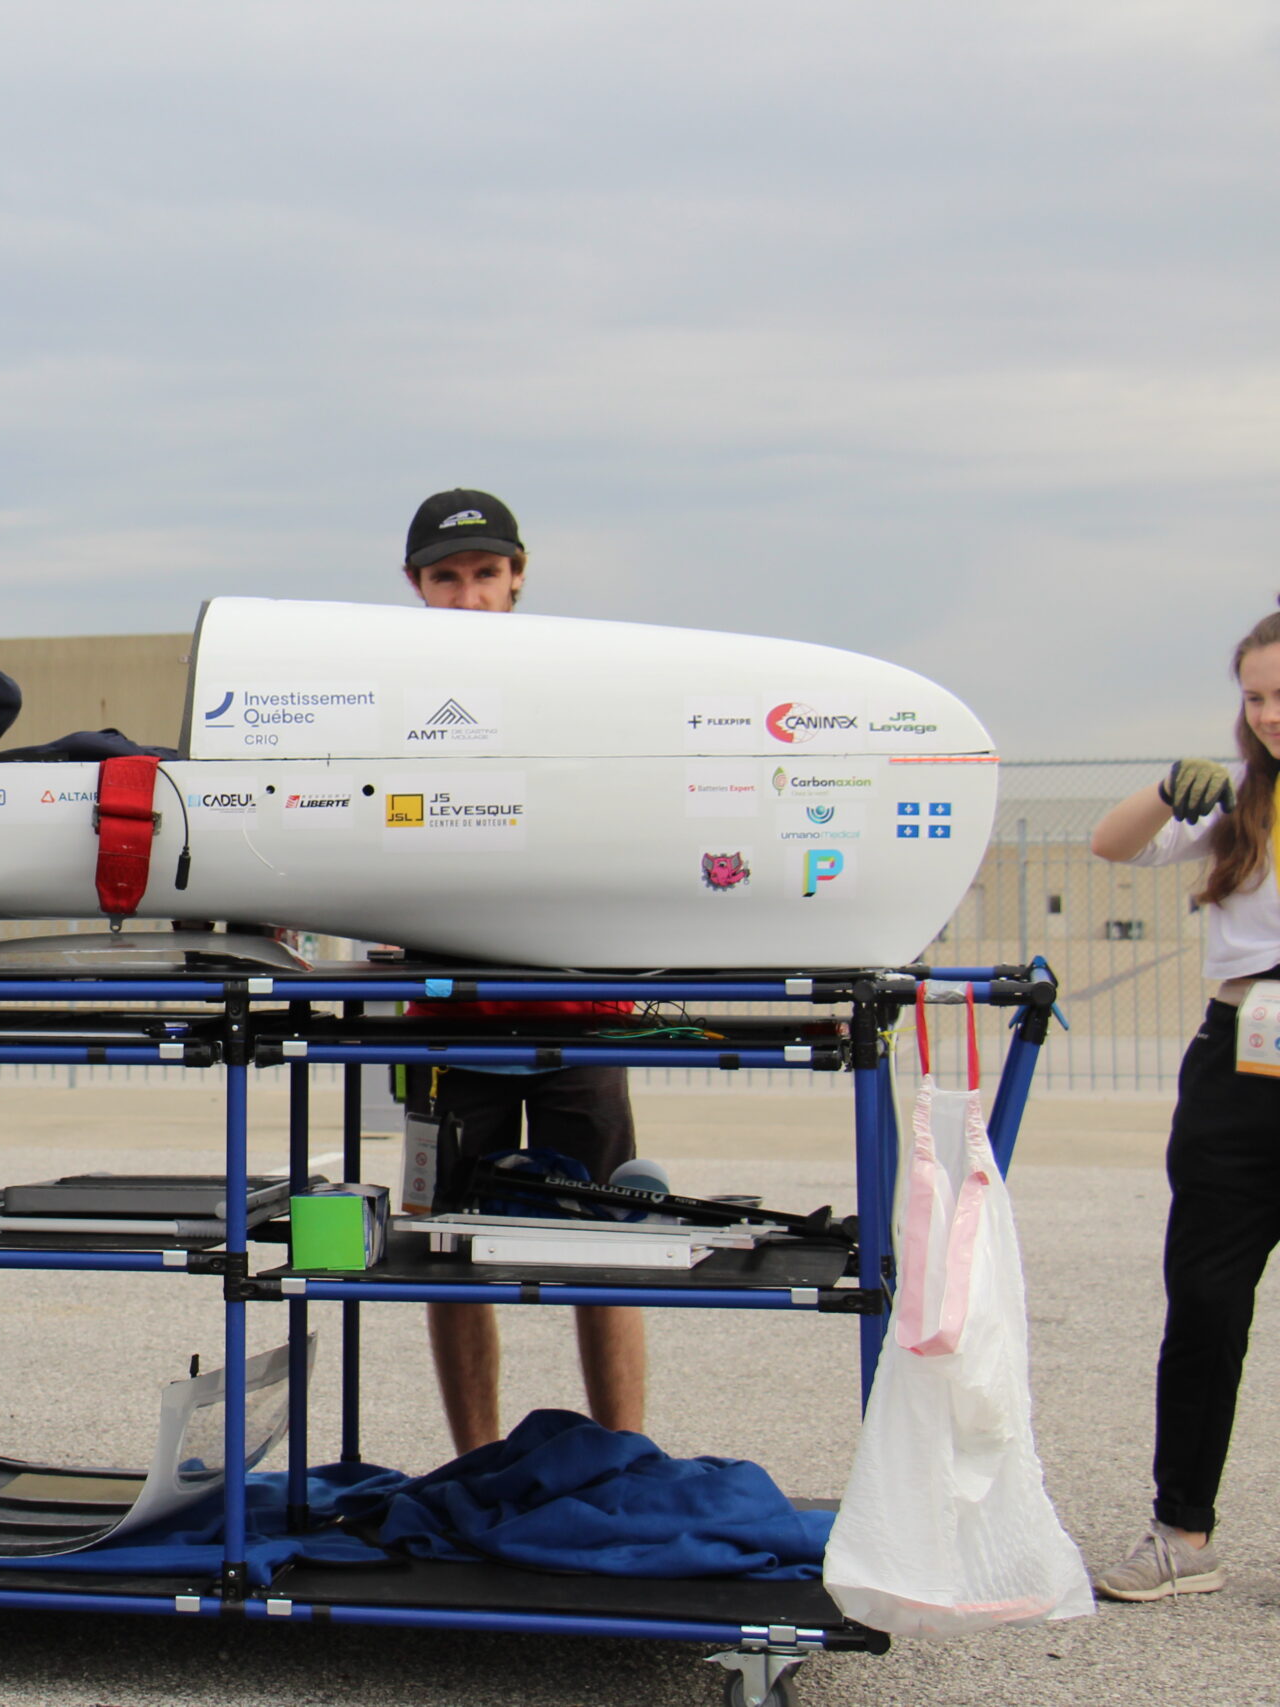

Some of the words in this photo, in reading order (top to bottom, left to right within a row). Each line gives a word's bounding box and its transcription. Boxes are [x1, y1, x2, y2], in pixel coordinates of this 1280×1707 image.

[244, 691, 375, 706] Investissement
[243, 708, 315, 727] Québec
[707, 718, 751, 726] FLEXPIPE
[785, 715, 858, 729] CANIMEX
[889, 712, 916, 721] JR
[870, 722, 937, 734] Levage
[244, 734, 279, 745] CRIQ
[407, 729, 448, 740] AMT
[791, 776, 872, 787] Carbonaxion
[729, 784, 755, 793] Expert
[430, 793, 451, 803] JS
[430, 805, 524, 816] LEVESQUE
[387, 813, 413, 822] JSL
[430, 819, 461, 828] CENTRE
[463, 819, 473, 827] DE
[476, 818, 508, 827] MOTEUR
